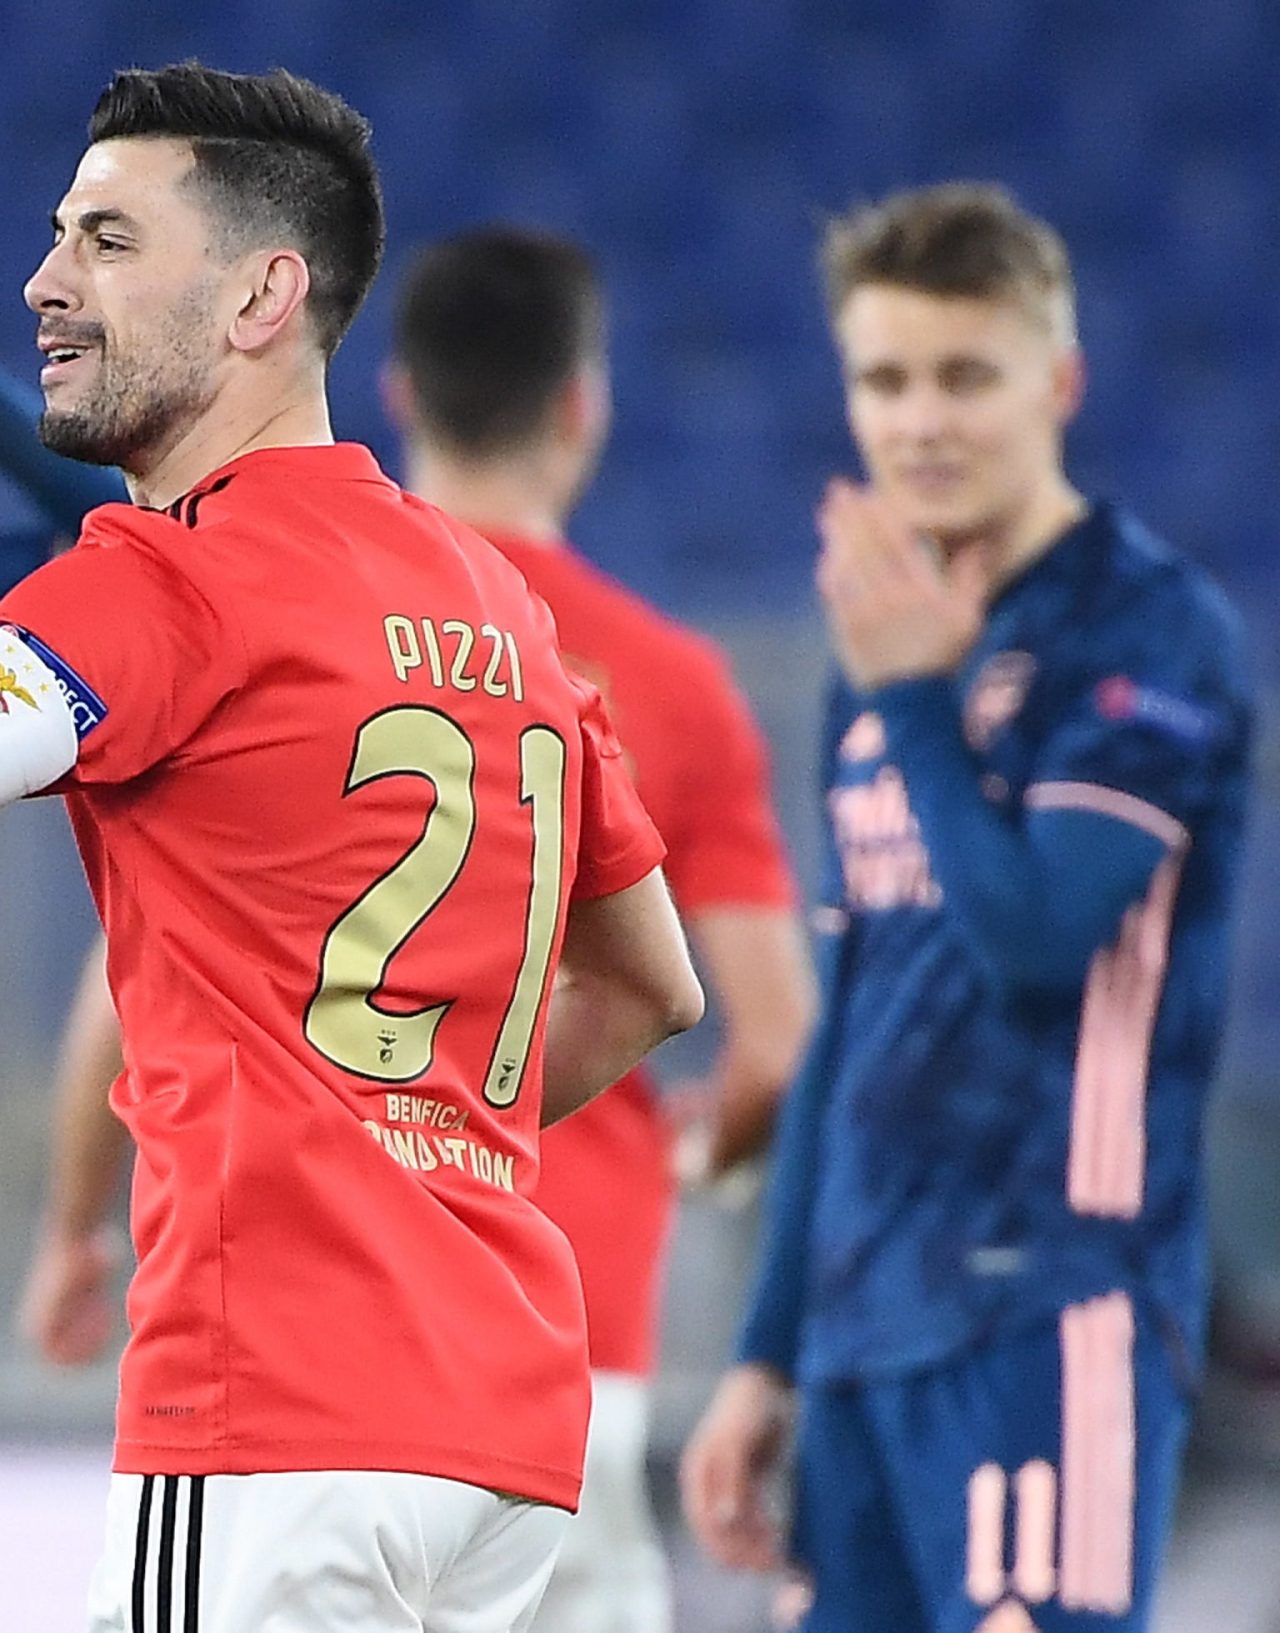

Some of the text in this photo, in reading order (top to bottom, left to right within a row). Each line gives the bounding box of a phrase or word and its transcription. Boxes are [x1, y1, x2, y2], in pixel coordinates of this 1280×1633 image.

[383, 613, 524, 703] PIZZI
[56, 678, 99, 732] PECT
[303, 702, 566, 1109] 21
[385, 1093, 470, 1132] BENFICA
